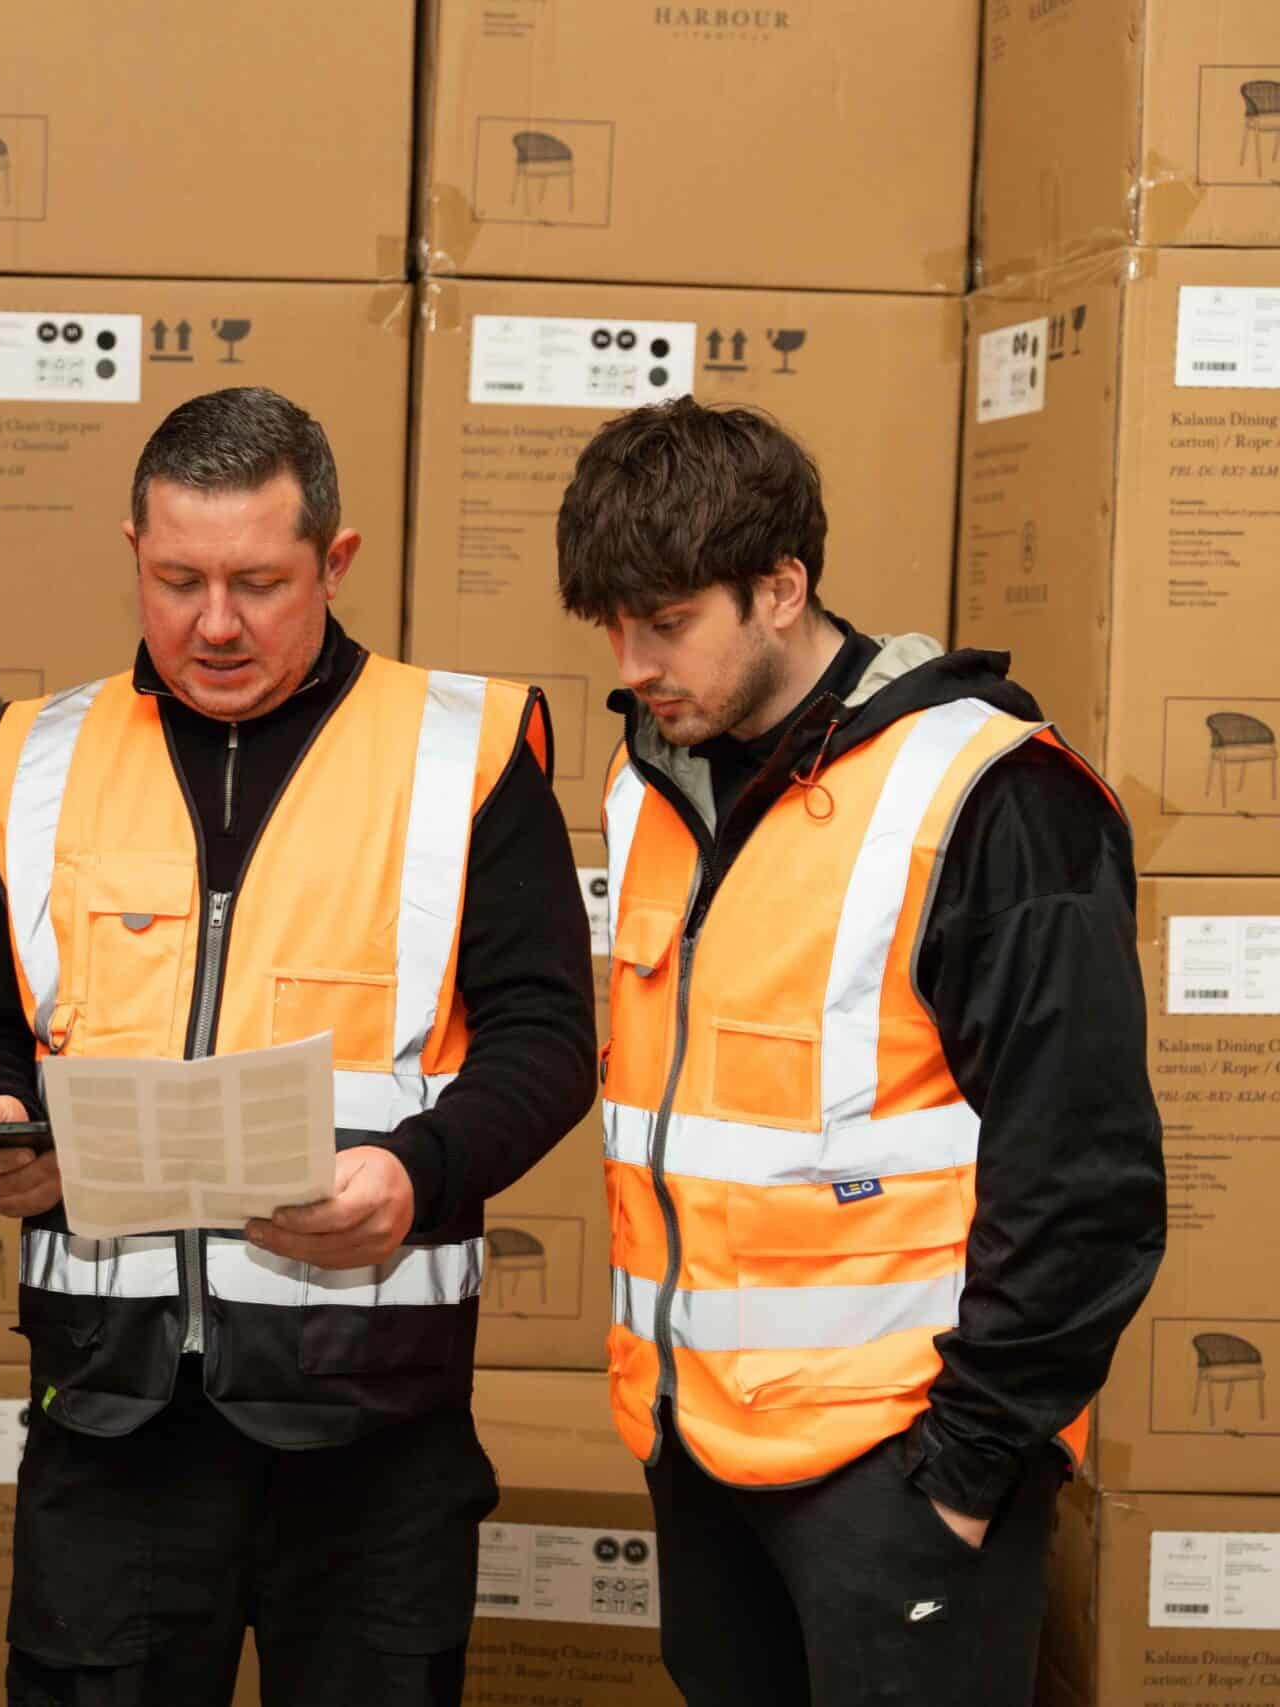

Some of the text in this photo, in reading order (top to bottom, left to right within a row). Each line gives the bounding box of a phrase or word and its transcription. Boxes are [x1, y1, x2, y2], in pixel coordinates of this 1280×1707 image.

[655, 7, 789, 28] HARBOUR
[1171, 410, 1278, 430] Kalama Dining
[1235, 434, 1273, 454] Rope
[1158, 1039, 1213, 1053] Kalama
[1216, 1038, 1265, 1055] Dining
[1222, 1060, 1259, 1078] Rope
[839, 1181, 874, 1197] LEO
[1144, 1648, 1200, 1665] Kalama
[1201, 1648, 1250, 1670] Dining
